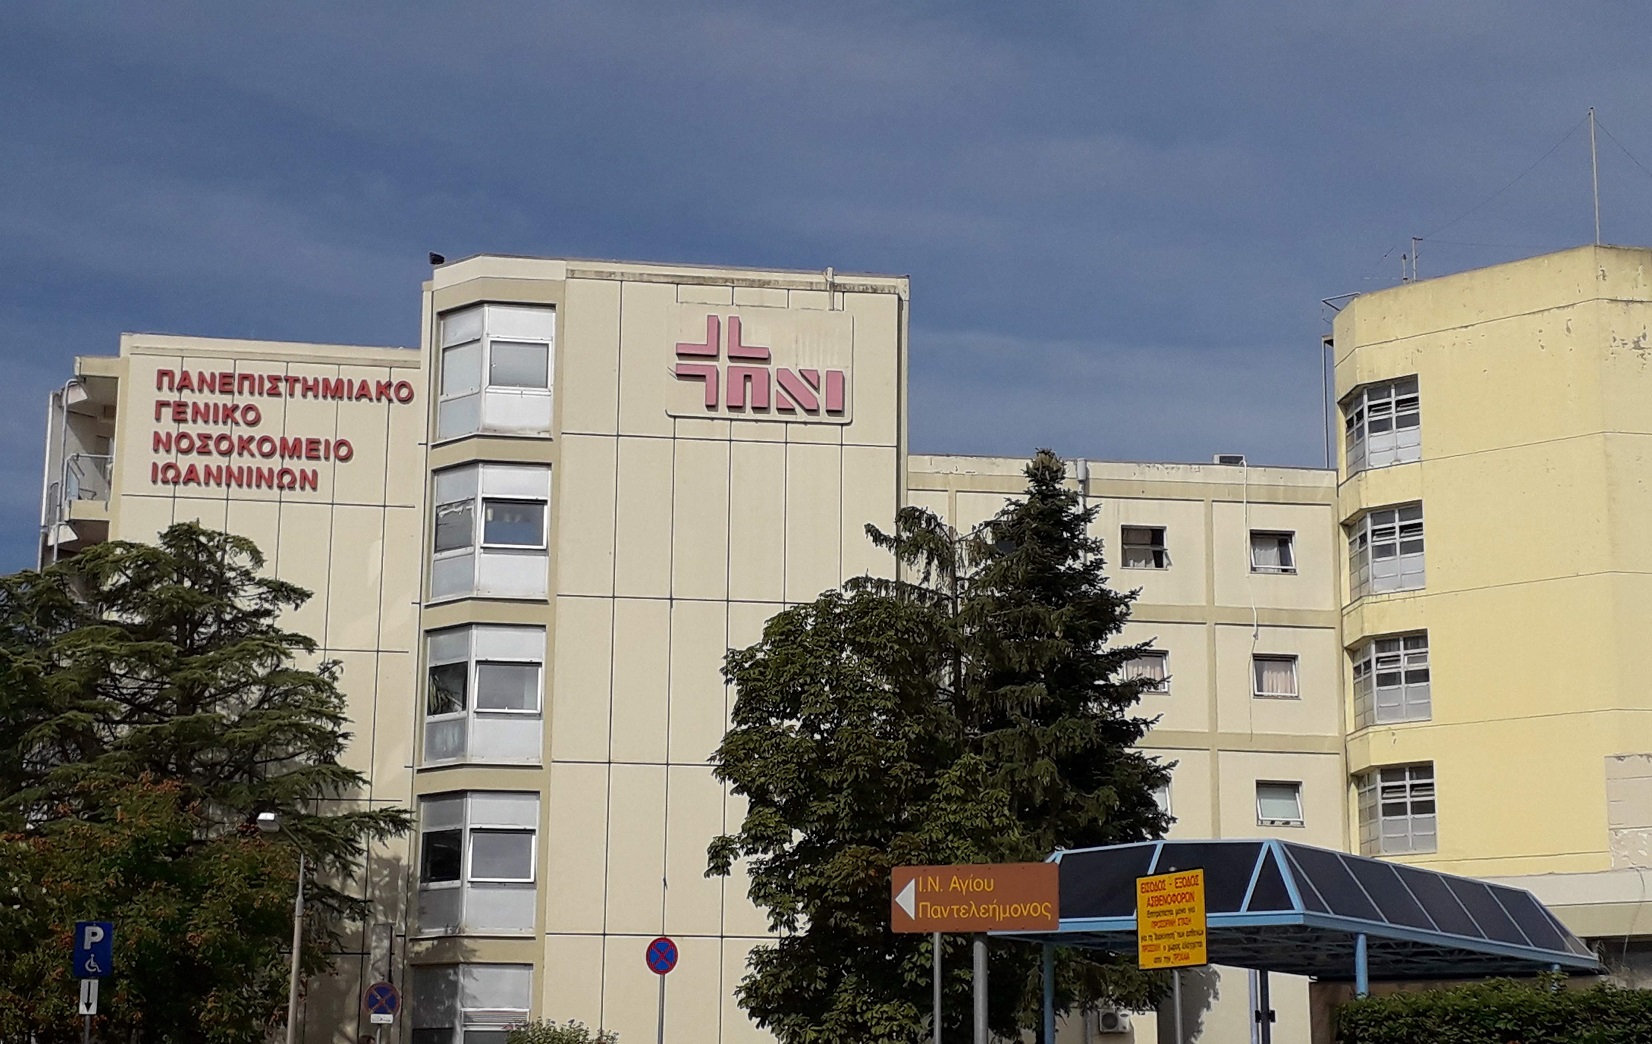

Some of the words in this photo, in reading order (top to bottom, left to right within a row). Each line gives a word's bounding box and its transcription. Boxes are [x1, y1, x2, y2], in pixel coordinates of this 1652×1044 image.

[156, 369, 414, 404] ΠΑΝΕΠΙΣΤΗΜΙΑΚΟ
[154, 400, 261, 426] ΓΕΝΙΚΟ
[152, 430, 353, 461] ΝΟΣΟΚΟΜΕΙΟ
[151, 461, 318, 491] ΙΩΑΝΝΙΝΩΝ
[918, 875, 943, 893] Ι.Ν.
[949, 873, 994, 896] Αγίου
[1140, 879, 1167, 894] ΕΙΣΟΔΟΣ
[1174, 874, 1200, 889] ΕΞΟΔΟΣ
[918, 898, 1052, 922] Παντελεήμονος
[1146, 891, 1195, 908] ΑΣΘΕΝΟΦΟΡΩΝ
[83, 925, 105, 950] P
